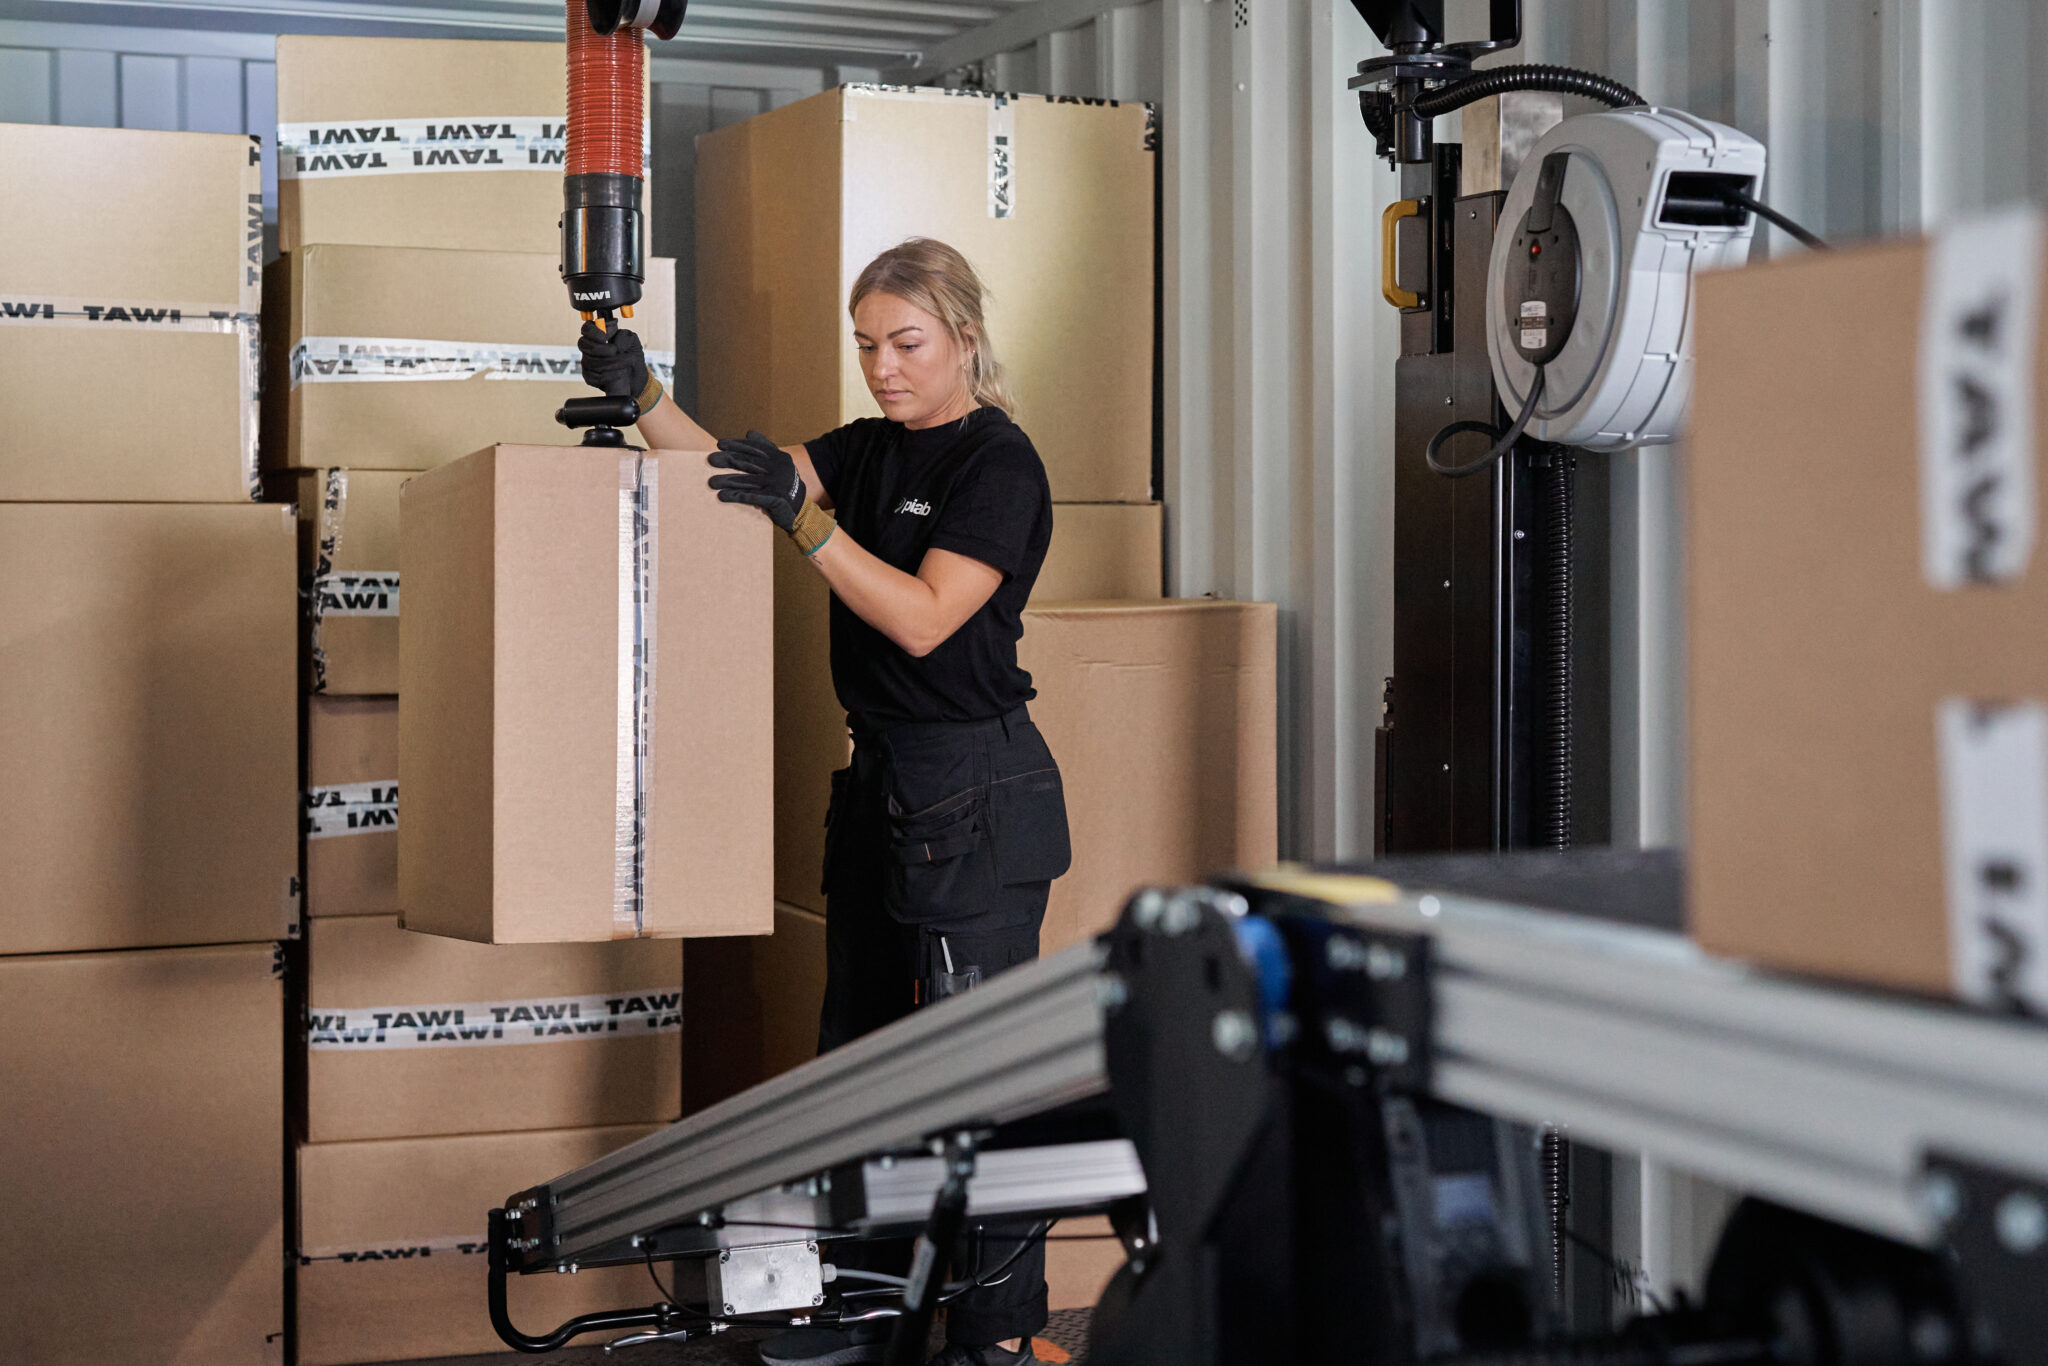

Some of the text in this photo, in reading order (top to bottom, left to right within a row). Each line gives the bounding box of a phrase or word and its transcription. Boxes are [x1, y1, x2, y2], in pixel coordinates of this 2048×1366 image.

[309, 123, 517, 146] TAWI TAWI
[296, 152, 388, 172] TAWI
[412, 148, 504, 167] TAWI
[247, 193, 263, 286] TAWI
[573, 290, 611, 301] TAWI
[83, 305, 181, 324] TAWI
[900, 498, 931, 516] piab
[319, 592, 389, 609] AWI
[372, 1009, 464, 1029] TAWI
[489, 1002, 580, 1023] TAWI
[604, 993, 681, 1015] TAW
[411, 1022, 503, 1042] TAWI
